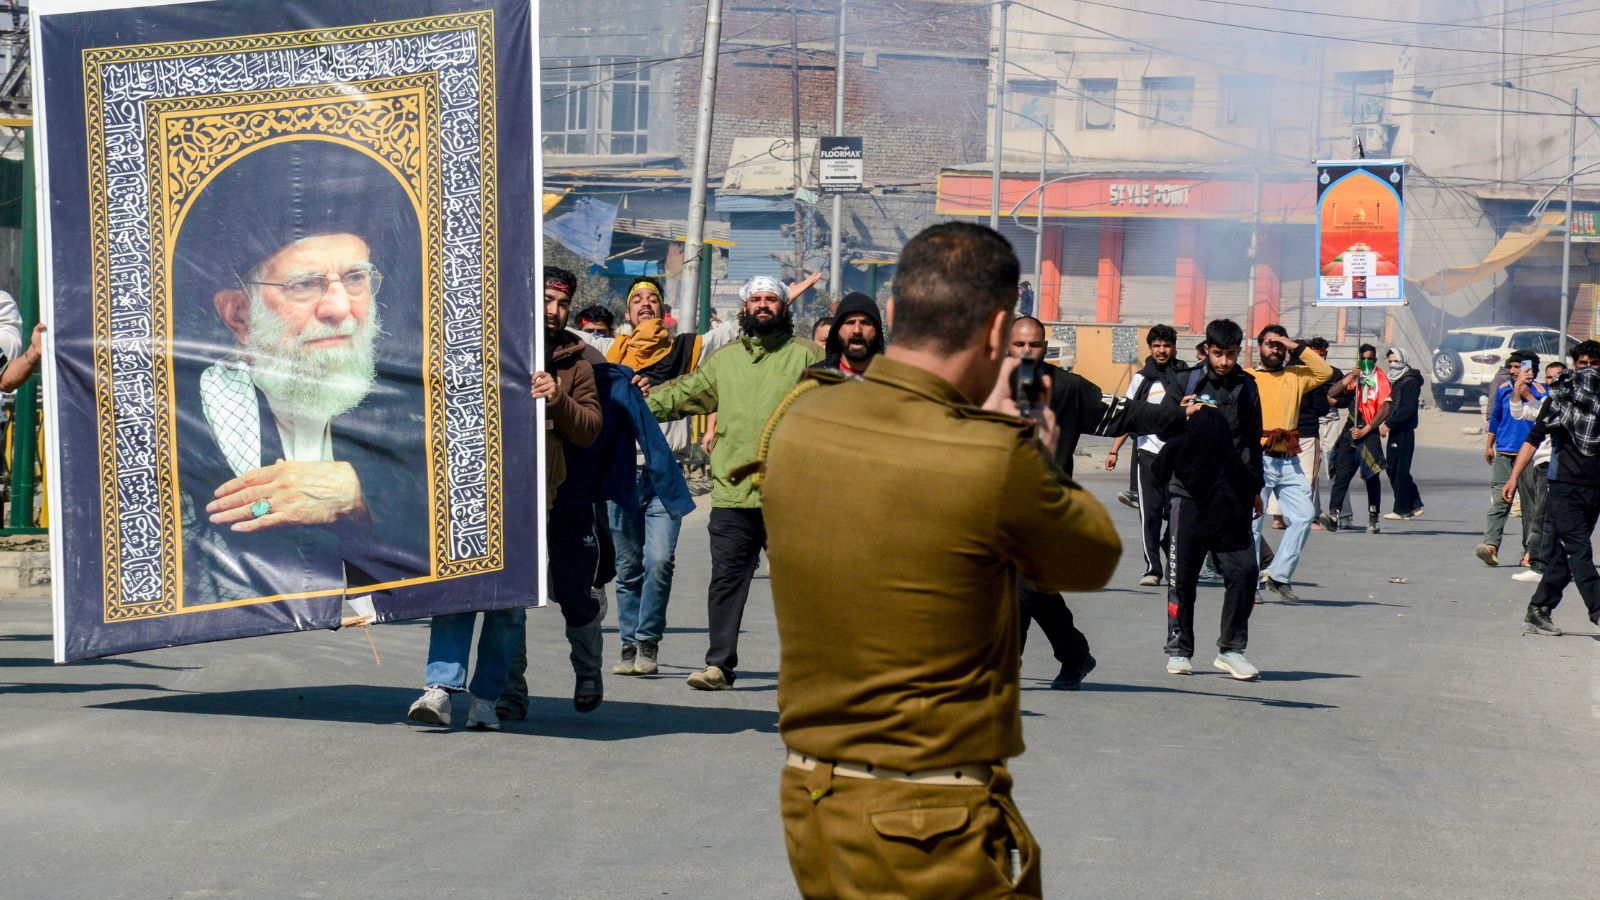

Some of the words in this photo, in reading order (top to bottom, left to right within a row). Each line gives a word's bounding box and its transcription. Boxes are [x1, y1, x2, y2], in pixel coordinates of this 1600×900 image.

[820, 150, 861, 158] FLOORMAX
[1109, 183, 1150, 206] STYLE
[1153, 184, 1192, 207] POINT
